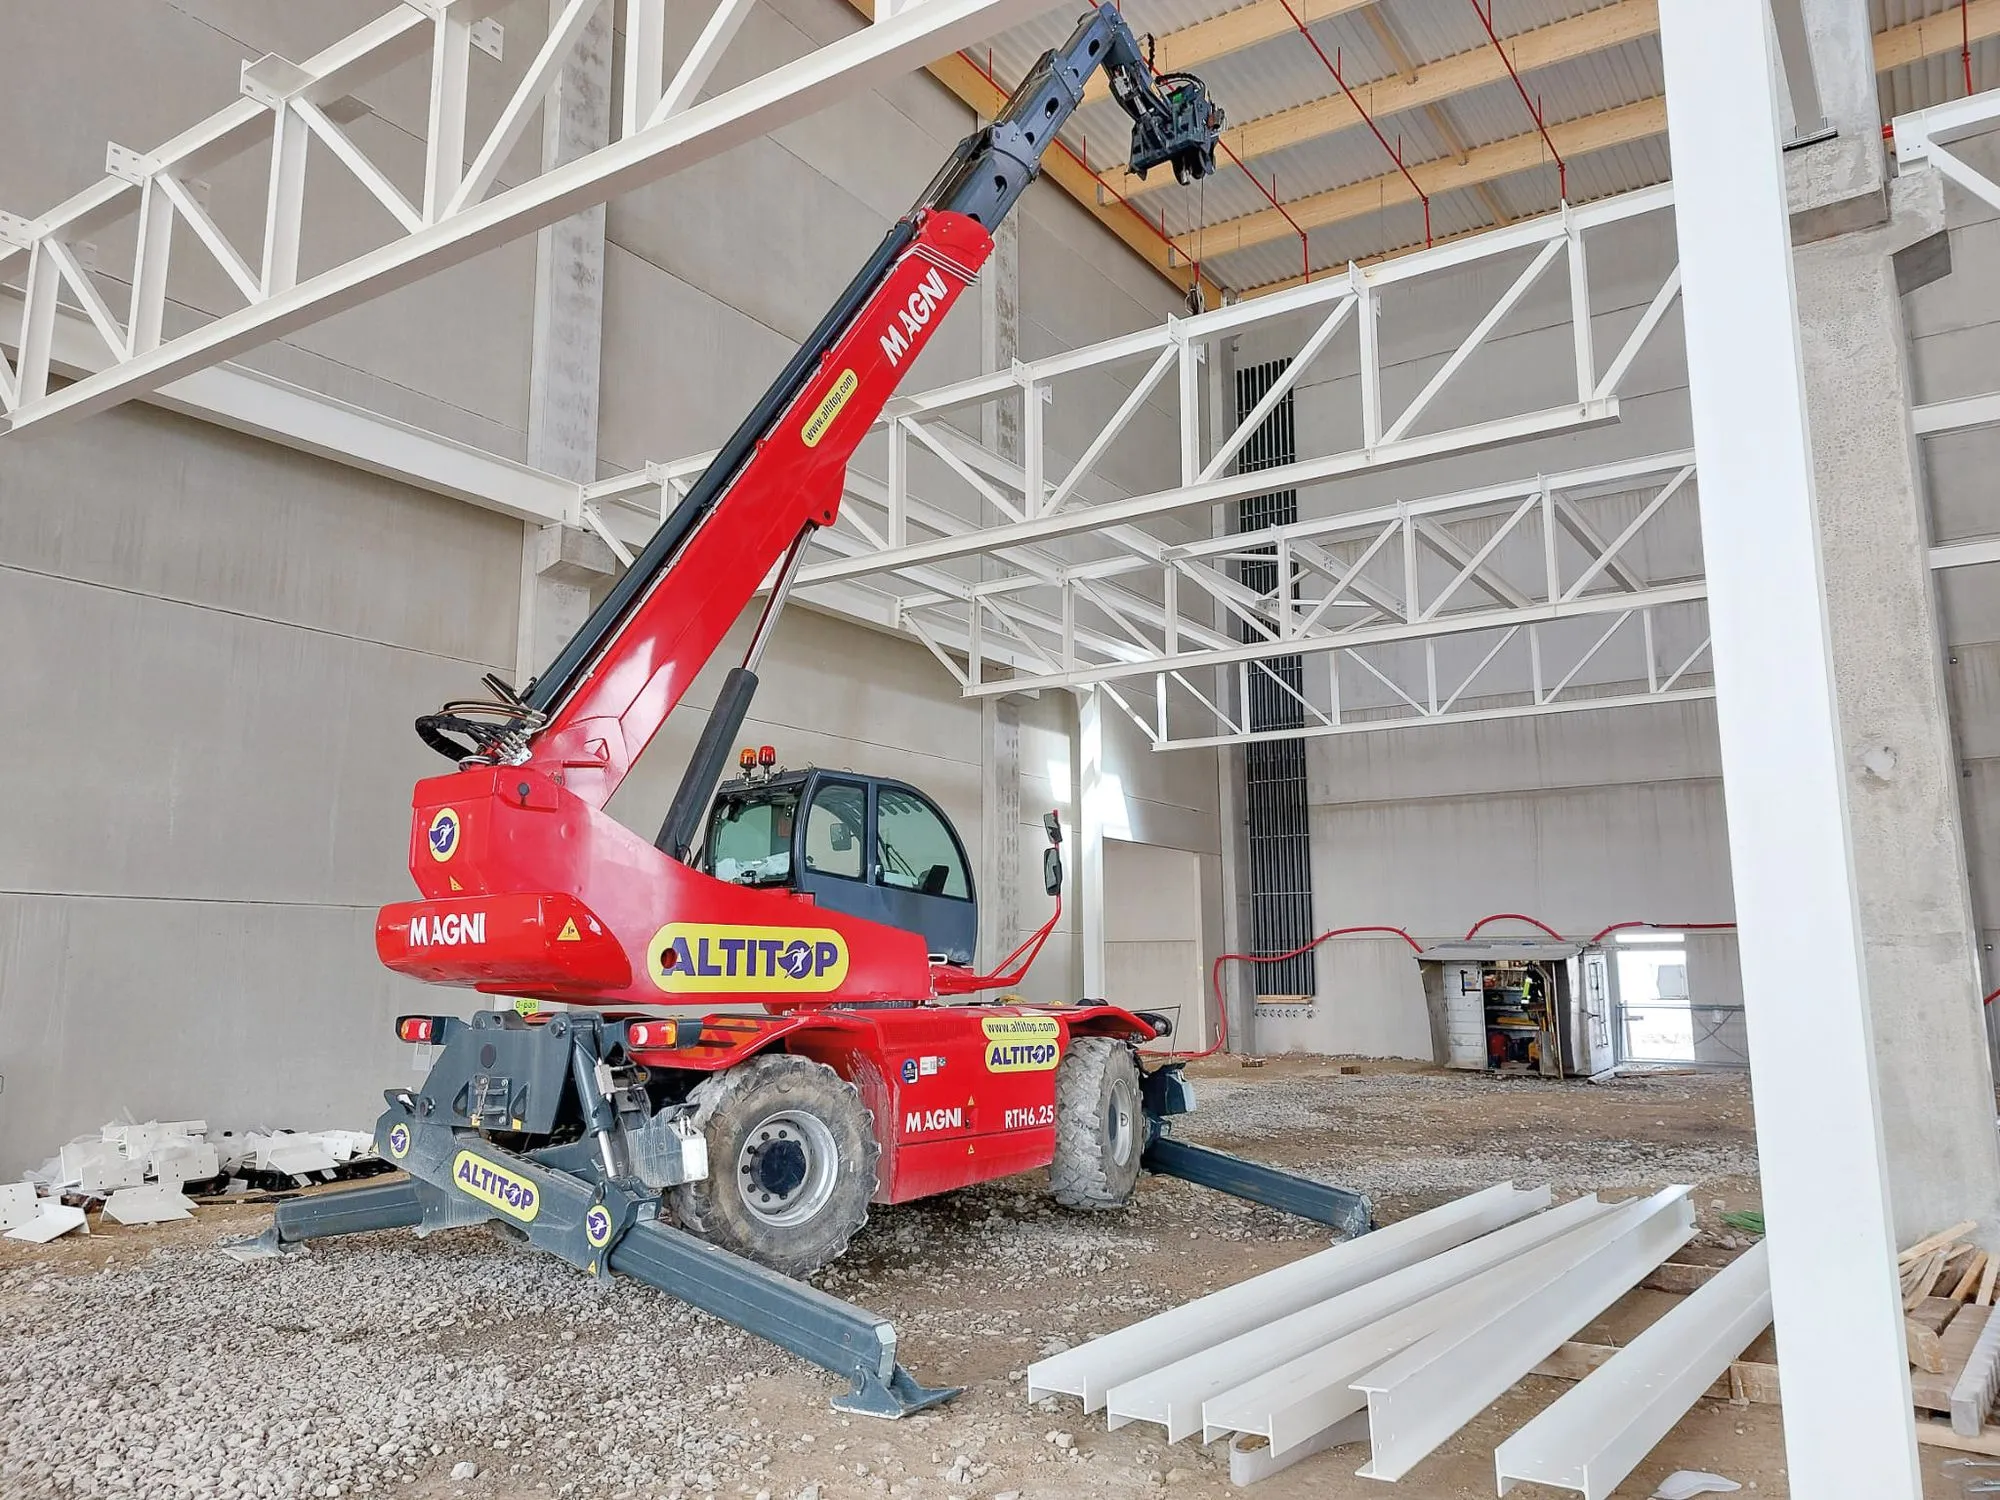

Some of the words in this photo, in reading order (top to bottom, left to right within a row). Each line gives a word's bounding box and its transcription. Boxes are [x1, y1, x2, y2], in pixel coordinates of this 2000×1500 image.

[879, 267, 948, 367] MAGNI
[806, 374, 854, 440] www.altitop.com
[410, 912, 486, 946] MAGNI
[661, 937, 838, 979] ALTITOP
[987, 1021, 1056, 1034] www.altitop.com
[990, 1045, 1055, 1065] ALTITOP
[905, 1107, 961, 1132] MAGNI
[1005, 1105, 1054, 1128] RTH6.25
[458, 1159, 534, 1210] ALTITOP
